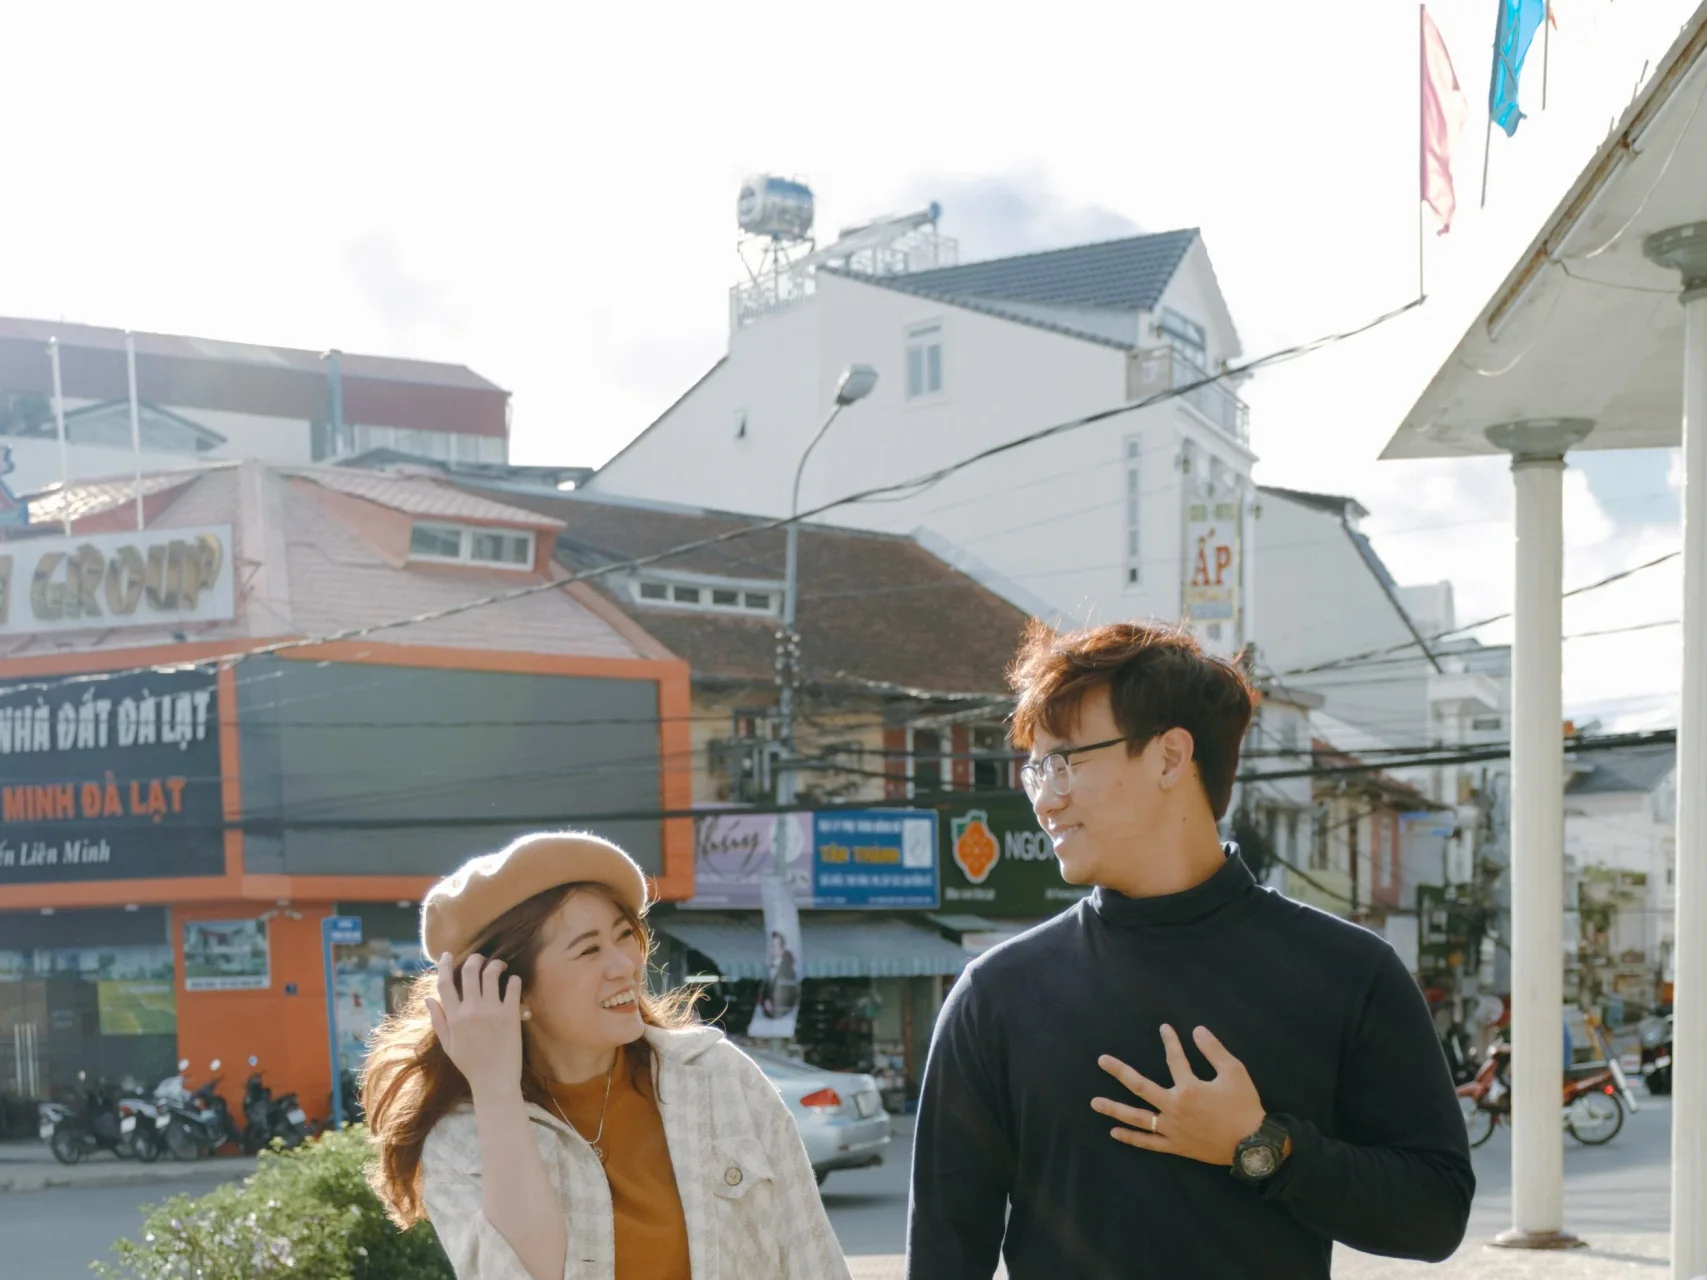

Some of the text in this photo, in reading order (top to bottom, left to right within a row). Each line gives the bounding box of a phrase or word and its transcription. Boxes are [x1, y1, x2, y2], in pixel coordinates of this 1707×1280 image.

[31, 532, 223, 621] GROUP
[57, 686, 111, 750] ĐẤT
[118, 688, 156, 746] ĐÀ
[161, 690, 210, 750] LẠT
[3, 770, 187, 823] MINH ĐÀ LẠT
[62, 838, 111, 864] Minh
[1004, 830, 1056, 861] NGO
